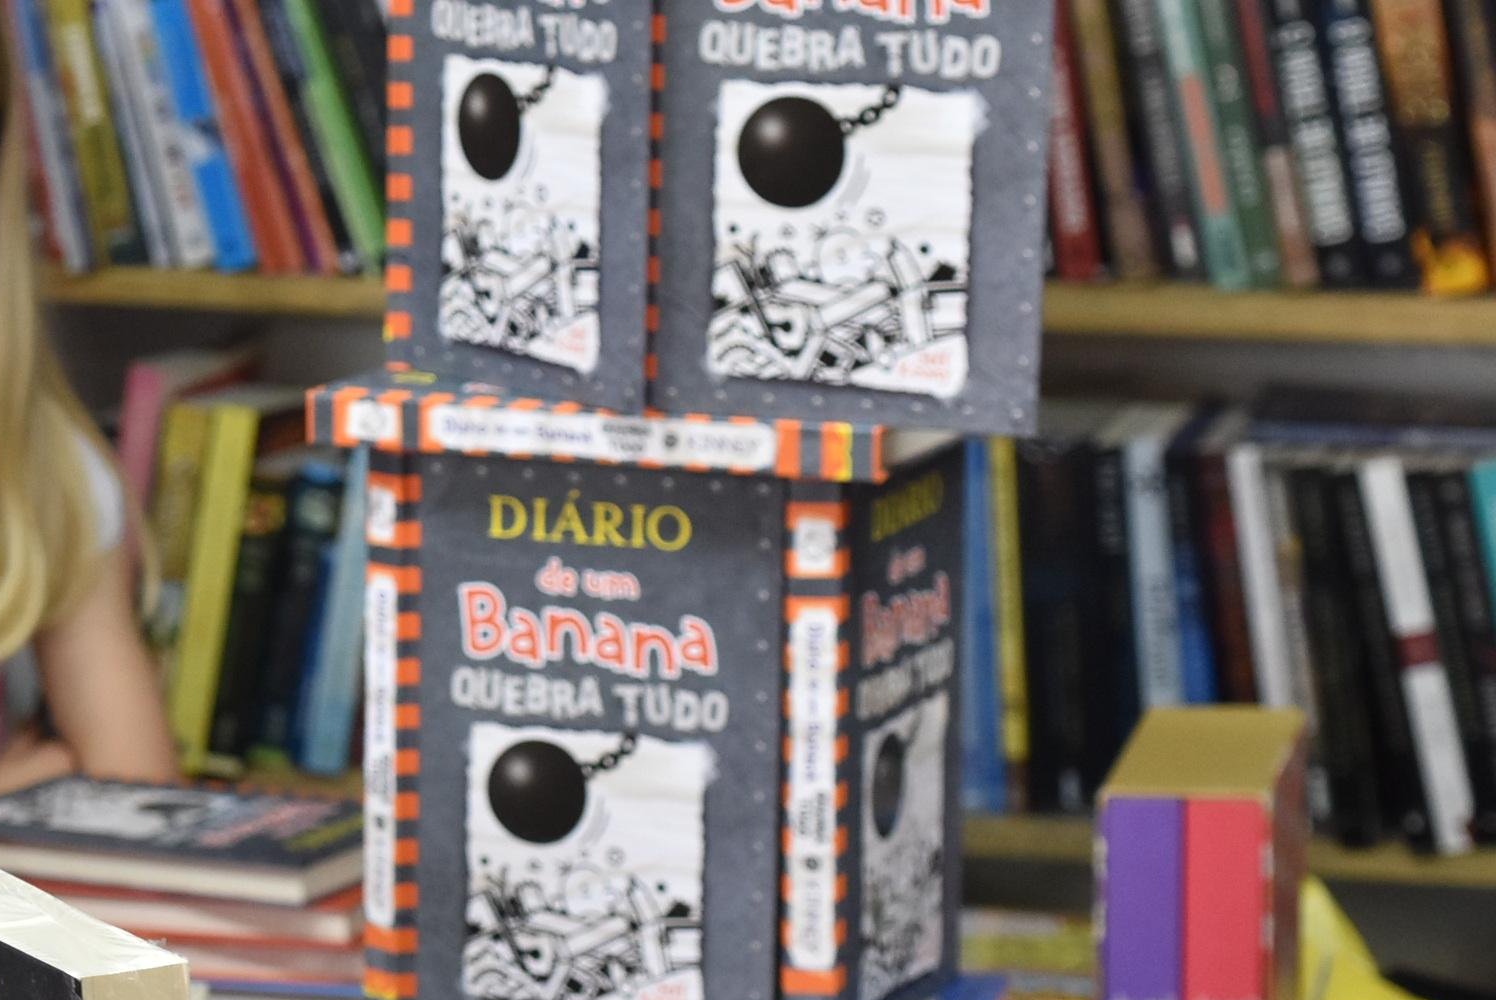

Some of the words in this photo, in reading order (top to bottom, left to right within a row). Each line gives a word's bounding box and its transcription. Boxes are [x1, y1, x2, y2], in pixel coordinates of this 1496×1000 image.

[431, 1, 535, 51] QUEBRA
[539, 13, 618, 64] TUDO
[700, 21, 865, 72] QUEBRA
[876, 31, 1002, 79] TUDO
[487, 489, 693, 552] DIÁRIO
[535, 556, 578, 597] de
[582, 569, 641, 600] um
[458, 580, 719, 681] Banana
[451, 666, 604, 720] QUEBRA
[613, 684, 730, 732] TUDO
